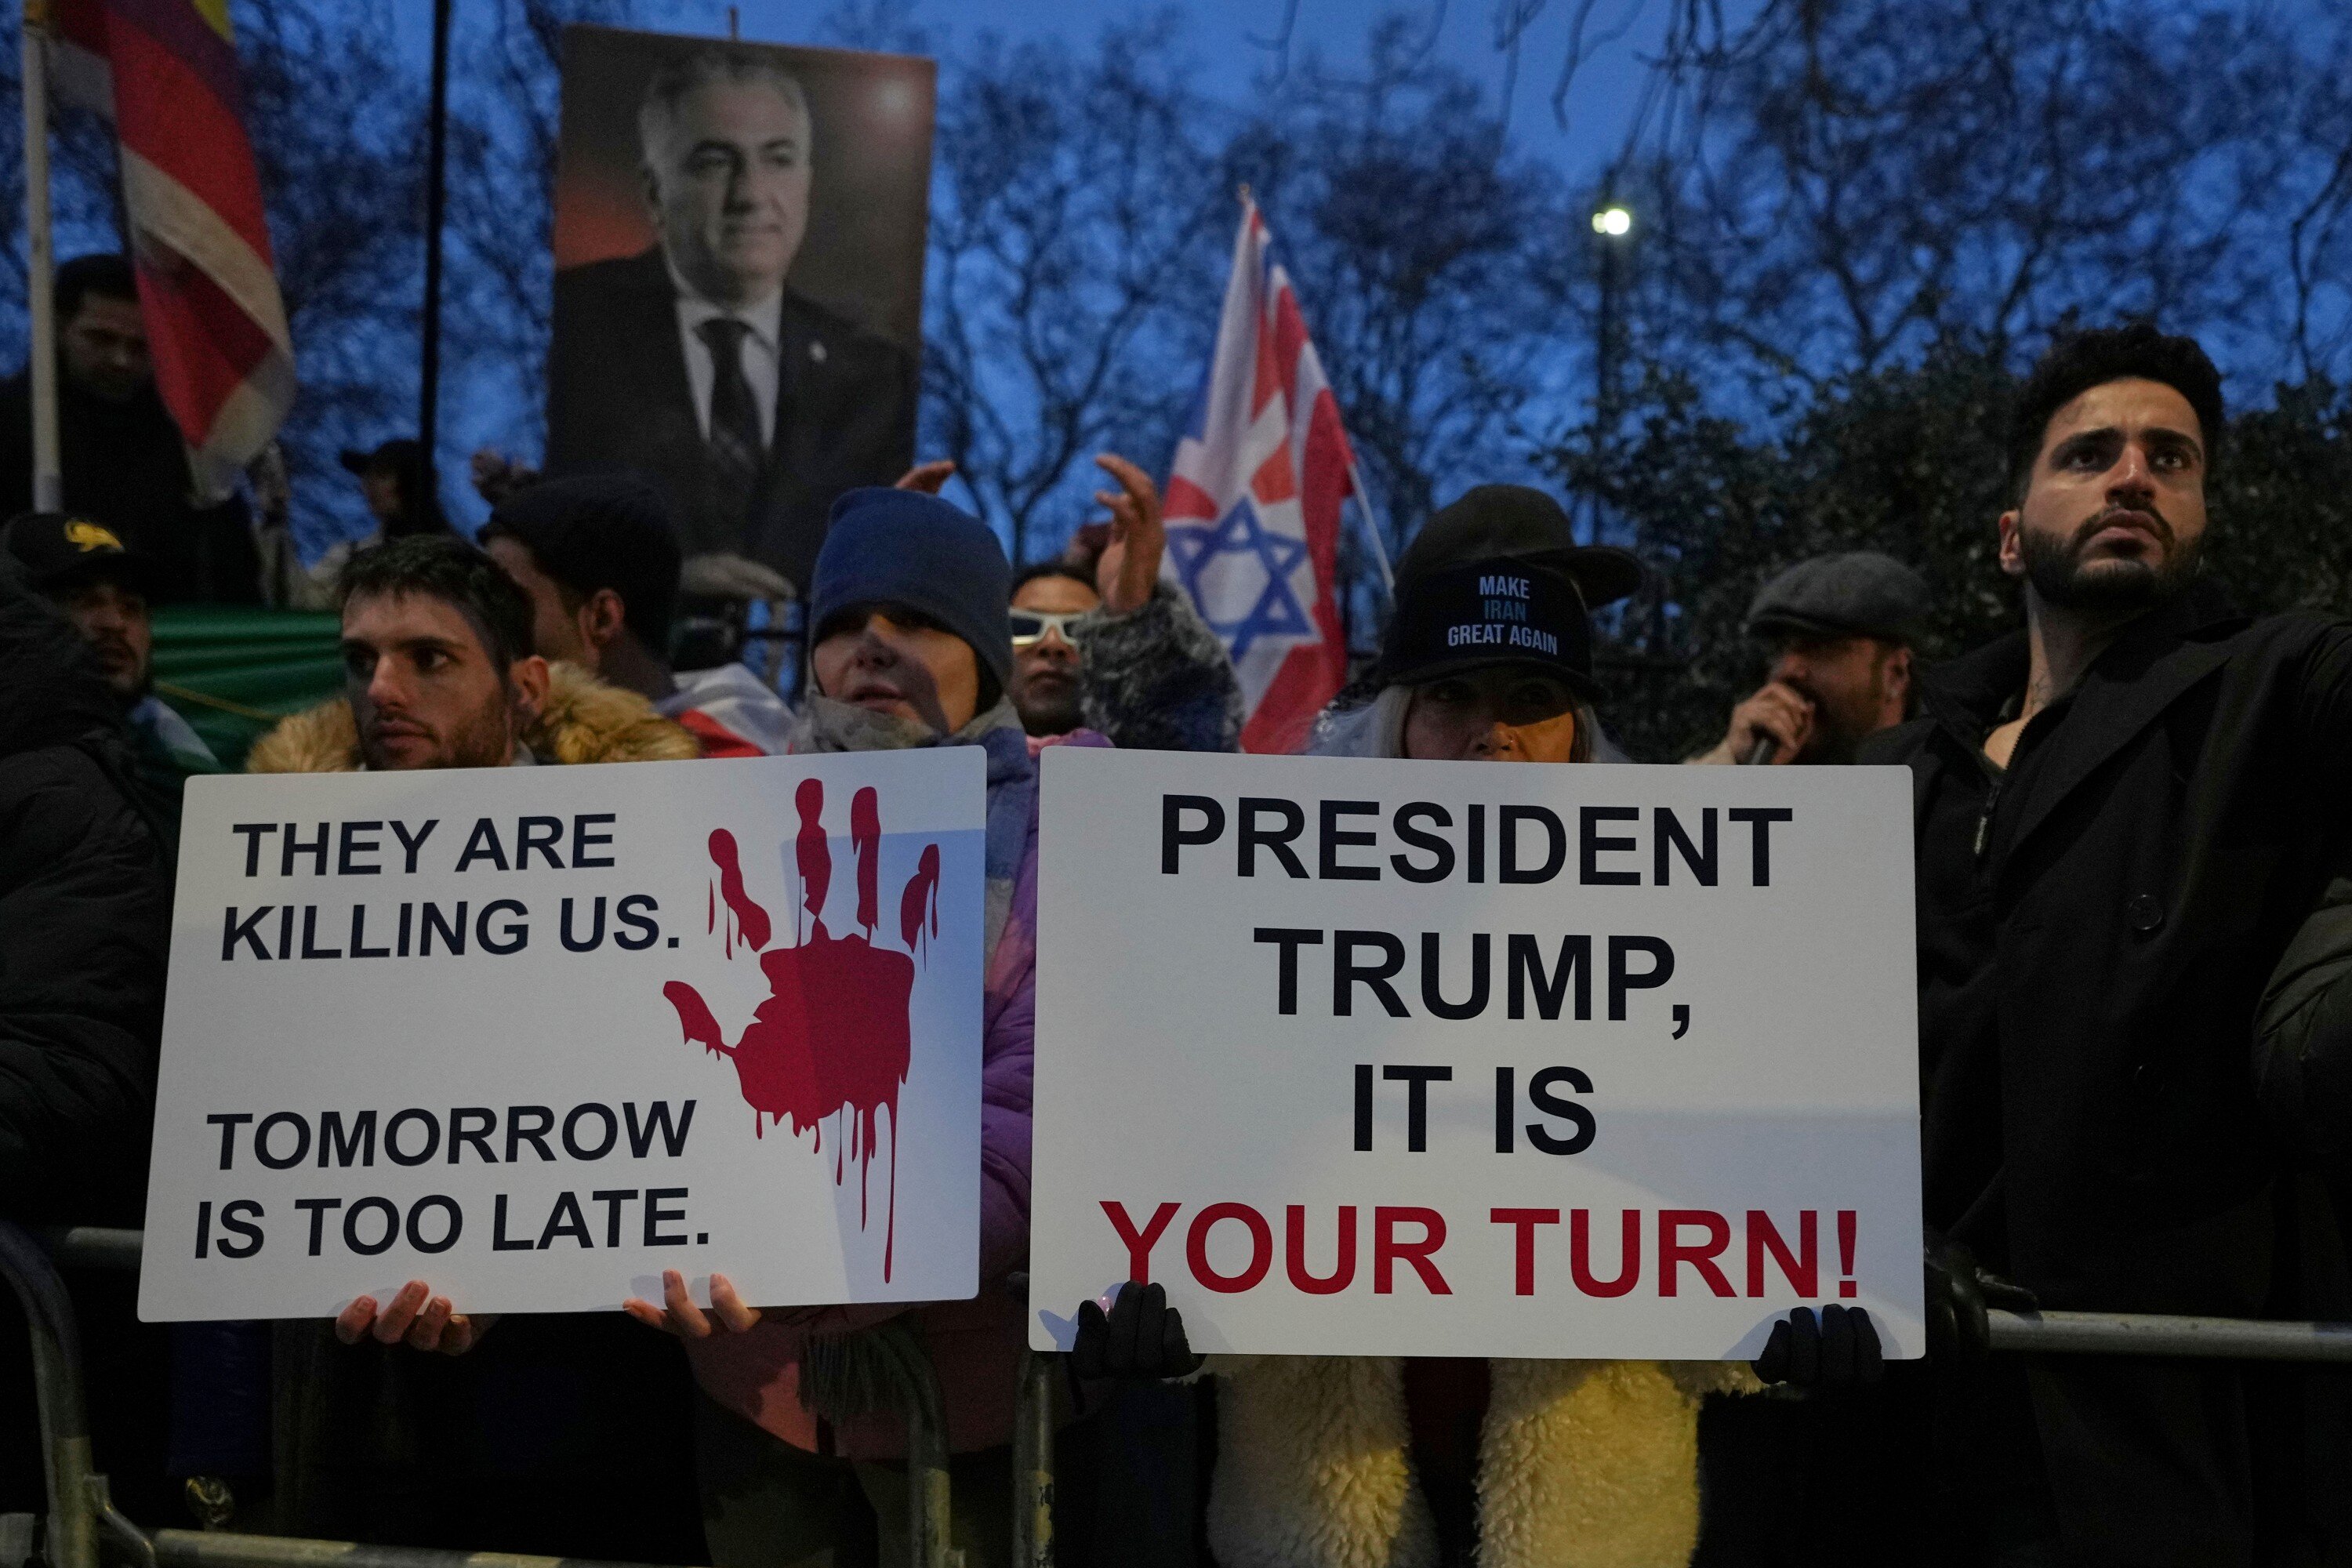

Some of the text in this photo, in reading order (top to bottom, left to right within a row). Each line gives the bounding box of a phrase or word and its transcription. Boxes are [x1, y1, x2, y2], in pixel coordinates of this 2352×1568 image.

[1479, 575, 1530, 599] MAKE
[1484, 599, 1526, 621] IRAN
[1447, 624, 1558, 655] GREAT AGAIN
[232, 813, 616, 878] THEY ARE
[1161, 793, 1793, 887] PRESIDENT
[221, 894, 680, 962] KILLING US.
[1253, 927, 1690, 1040] TRUMP,
[206, 1099, 698, 1171] TOMORROW
[1353, 1064, 1597, 1156] IT IS
[194, 1187, 709, 1260] IS TOO LATE.
[1098, 1200, 1858, 1298] YOUR TURN!
